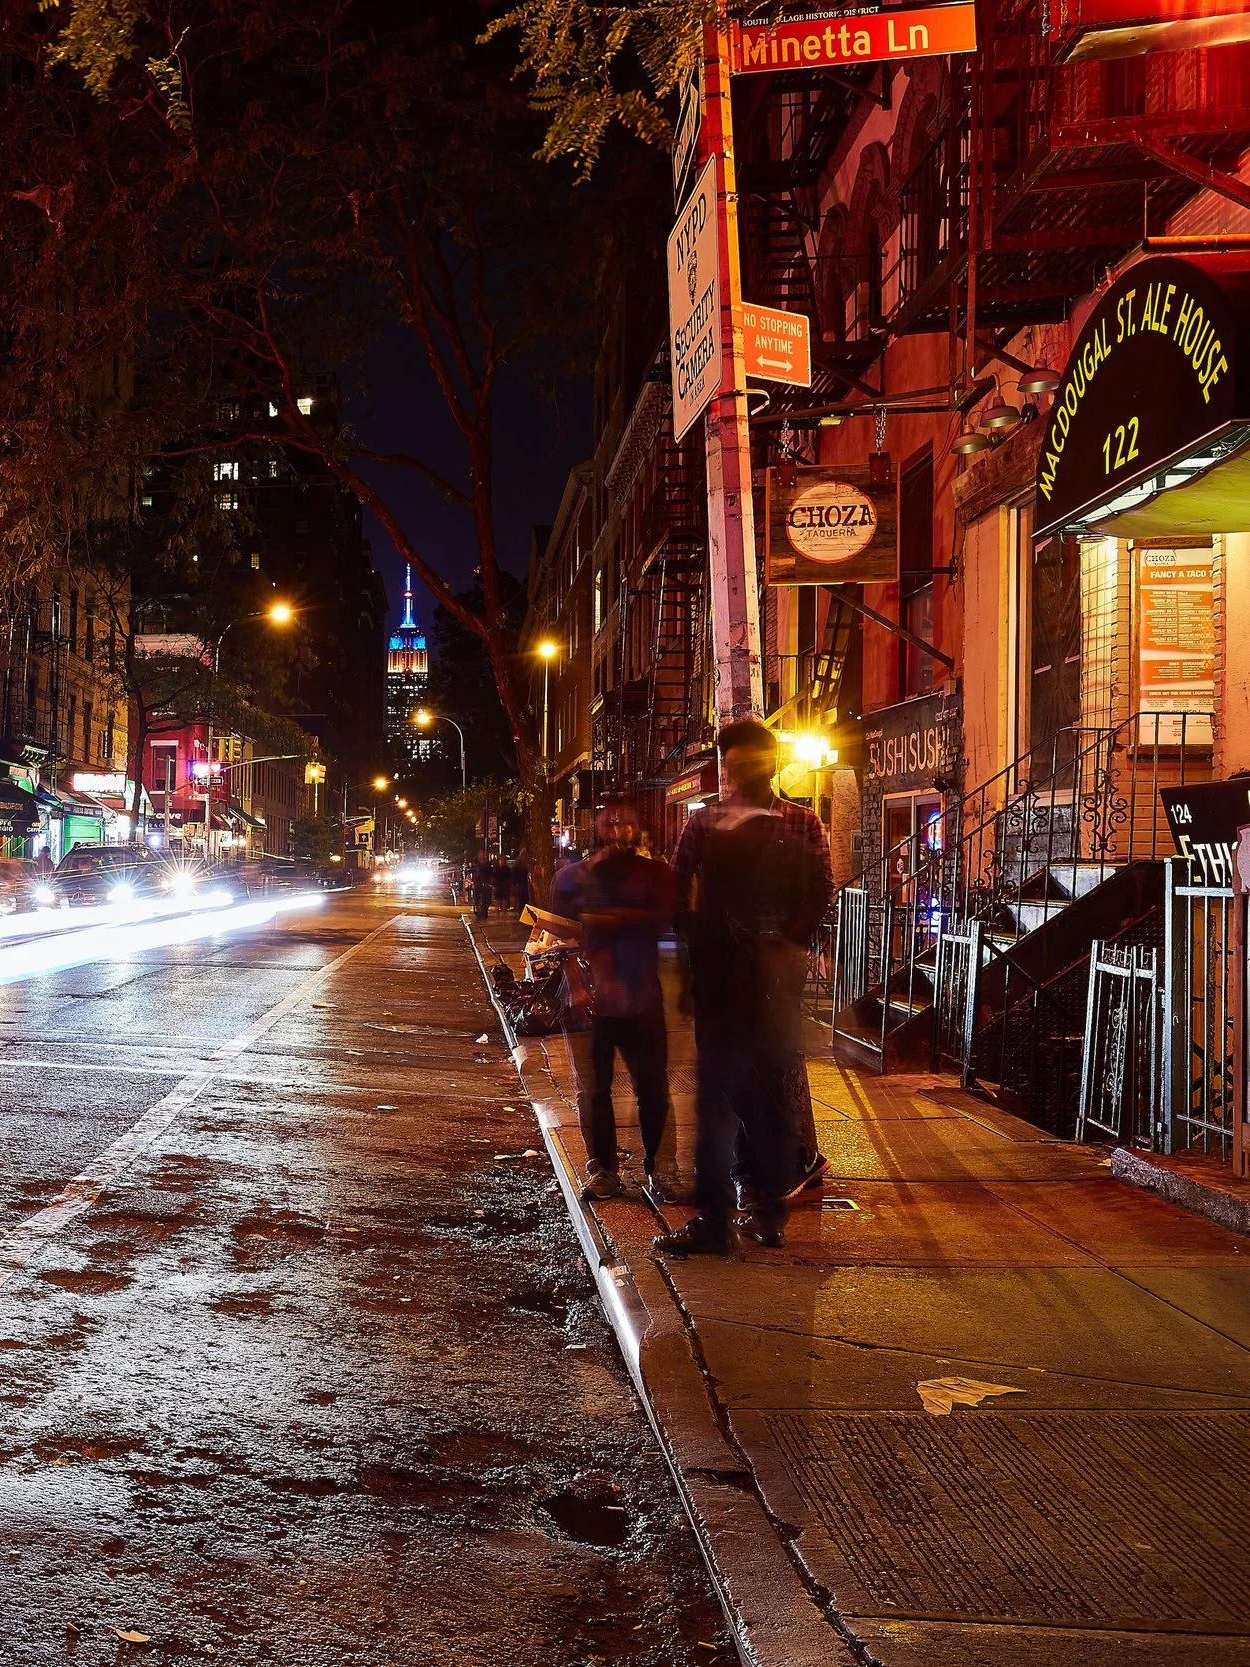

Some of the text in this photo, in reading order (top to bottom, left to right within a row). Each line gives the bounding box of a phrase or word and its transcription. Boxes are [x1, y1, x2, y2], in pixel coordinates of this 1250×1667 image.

[743, 18, 769, 27] SOUTH
[743, 20, 929, 66] Minetta Ln
[676, 192, 707, 273] NYPD
[675, 278, 716, 366] SECURITY
[743, 312, 803, 338] NO STOPPING
[755, 334, 793, 355] ANYTIME
[677, 325, 716, 401] CAMERA
[1039, 282, 1229, 502] MACDOUGAL ST. ALE HOUSE
[1103, 416, 1140, 475] 122
[788, 504, 875, 529] CHOZA
[1150, 570, 1176, 579] FANCY
[1178, 570, 1185, 578] A
[1186, 570, 1207, 578] TACO
[1170, 804, 1193, 824] 124
